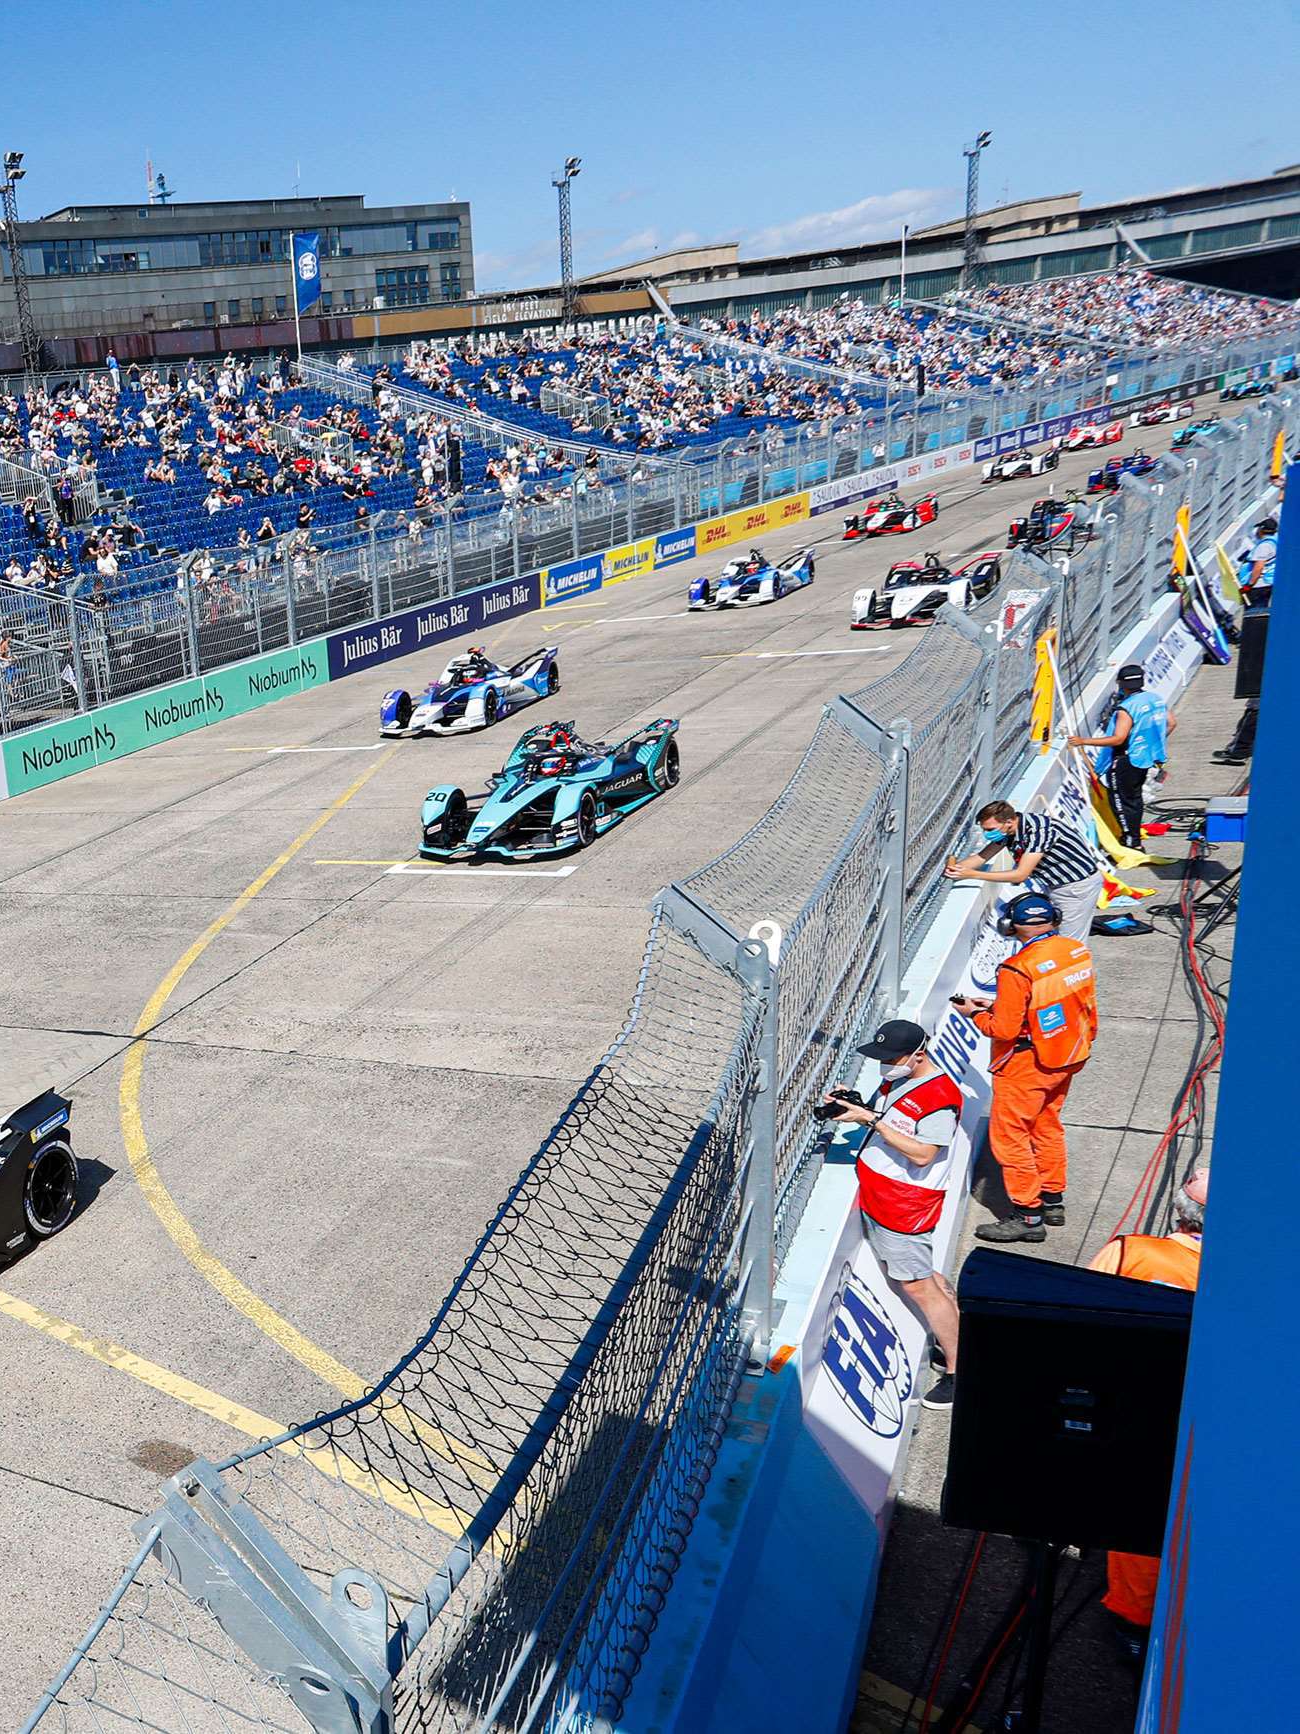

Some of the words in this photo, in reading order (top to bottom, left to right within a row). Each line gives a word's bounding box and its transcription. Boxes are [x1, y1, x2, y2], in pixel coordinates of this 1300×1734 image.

[515, 308, 557, 321] ELEVATION
[520, 300, 539, 311] FEET
[662, 536, 695, 554] MICHELIN
[613, 552, 649, 571] MICHELIN
[557, 567, 598, 590] MICHELIN
[482, 591, 511, 620] Julius
[512, 585, 530, 607] Bär
[417, 613, 449, 642] Julius
[450, 604, 470, 627] Bär
[342, 635, 378, 668] Julius
[380, 625, 403, 650] Bär
[603, 773, 643, 793] JAGUAR
[425, 792, 447, 803] 20
[926, 1013, 980, 1085] rive
[821, 1286, 897, 1426] FIA
